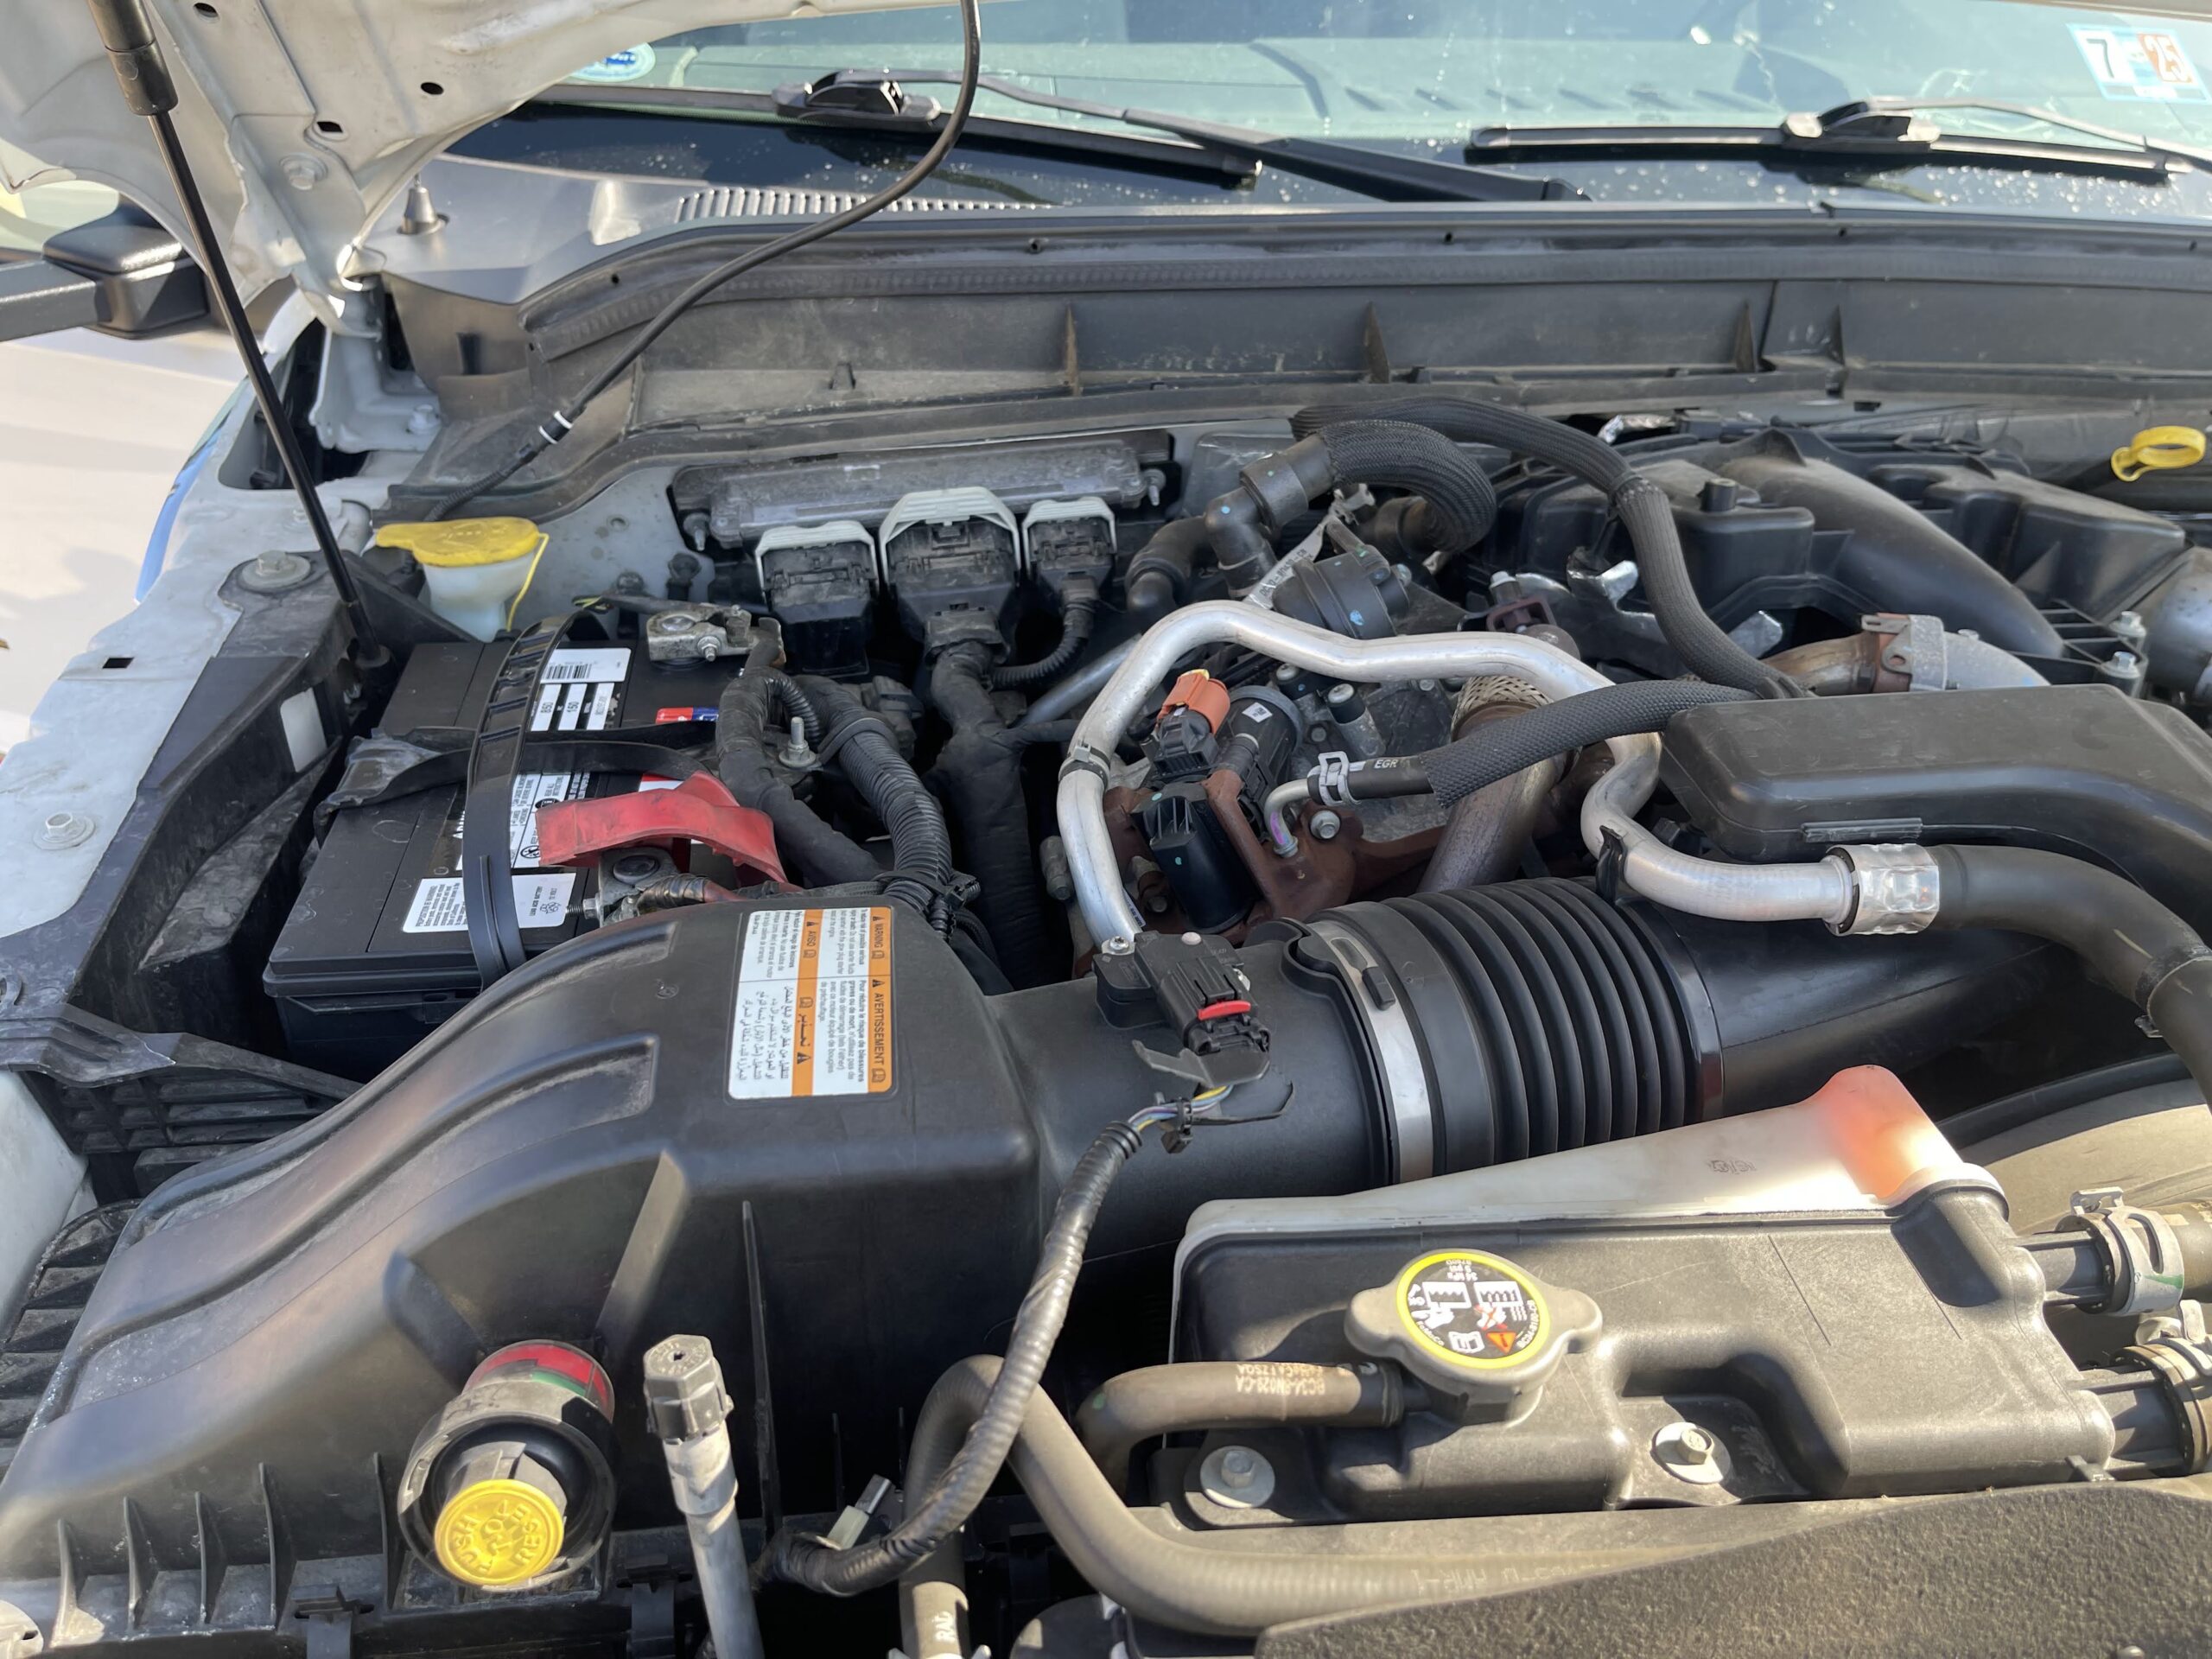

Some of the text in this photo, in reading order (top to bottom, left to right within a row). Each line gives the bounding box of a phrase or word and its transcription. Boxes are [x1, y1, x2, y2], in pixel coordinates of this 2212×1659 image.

[2086, 38, 2114, 79] 7
[1374, 759, 1400, 769] EGR
[806, 931, 817, 946] AVISO
[874, 924, 883, 948] WARNING
[874, 993, 885, 1065] AVERTISSEMENT
[848, 1071, 855, 1080] de
[1416, 1321, 1444, 1346] FoMoCo
[452, 1514, 493, 1575] PUSH
